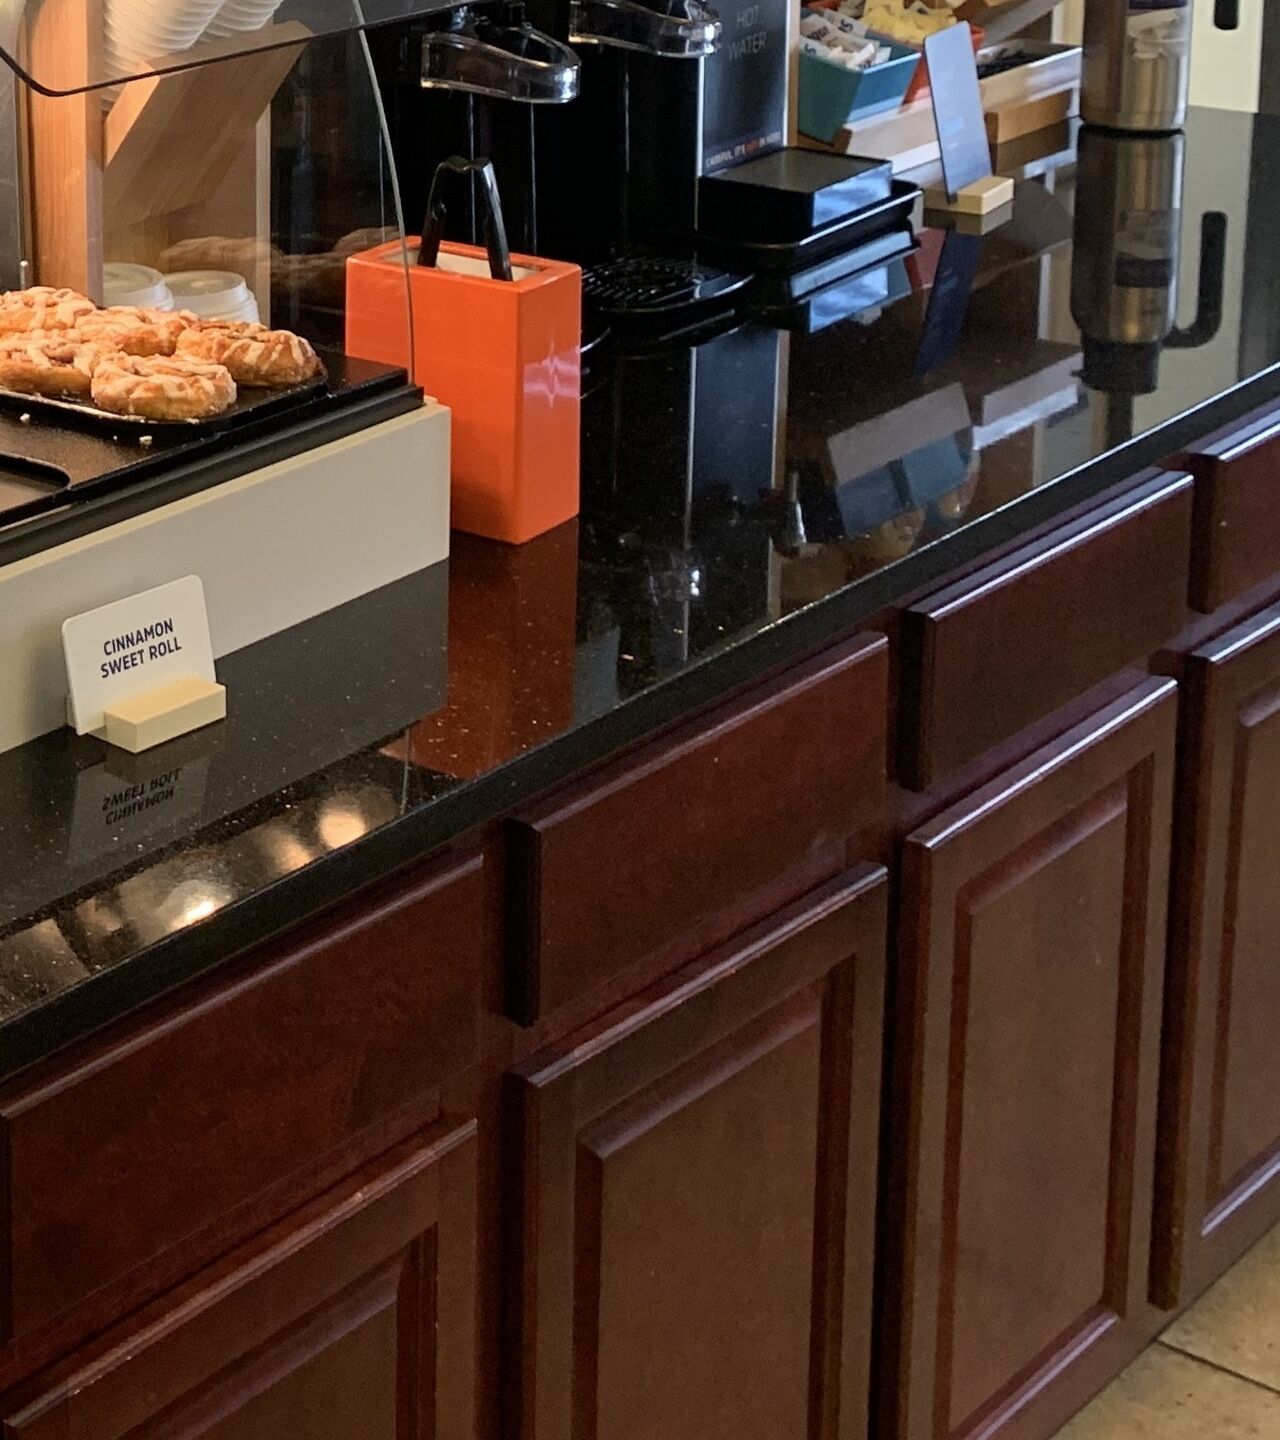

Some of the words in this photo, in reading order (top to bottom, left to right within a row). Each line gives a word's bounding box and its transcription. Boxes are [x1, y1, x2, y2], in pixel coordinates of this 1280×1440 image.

[736, 5, 760, 29] HOT
[728, 31, 768, 60] WATER
[103, 618, 173, 656] CINNAMON
[100, 649, 144, 678] SWEET
[149, 637, 182, 660] ROLL
